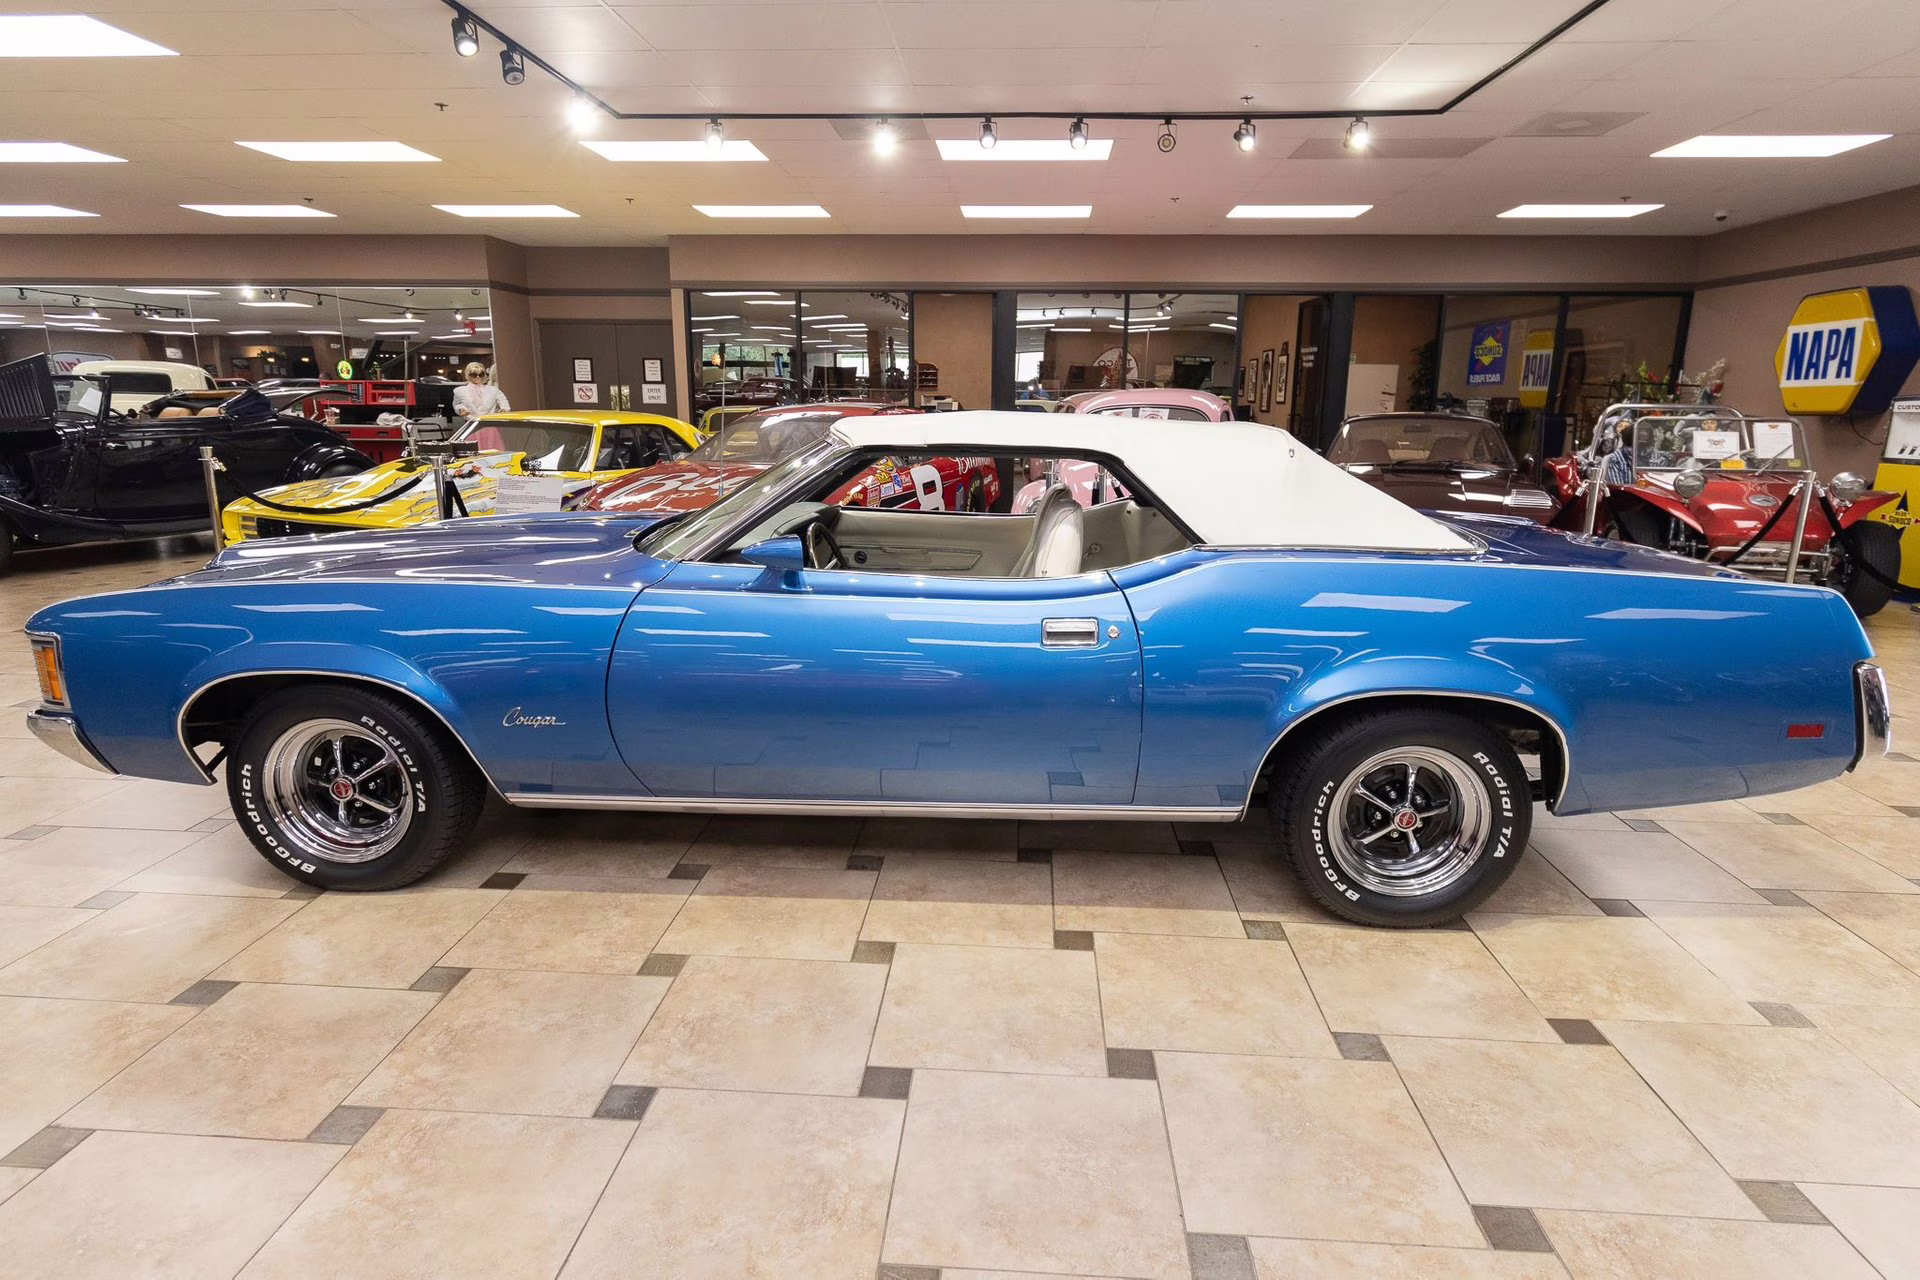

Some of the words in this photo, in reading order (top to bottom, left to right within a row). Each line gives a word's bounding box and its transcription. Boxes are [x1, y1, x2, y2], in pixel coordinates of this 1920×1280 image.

[1786, 327, 1857, 381] NAPA
[360, 715, 418, 773] Radial
[415, 780, 427, 813] T/A
[502, 706, 567, 728] Cougar
[241, 763, 317, 874] BFGoodrich
[1311, 780, 1361, 902] BFGoodrich
[1472, 752, 1514, 818] Radial
[1493, 825, 1513, 858] T/A
